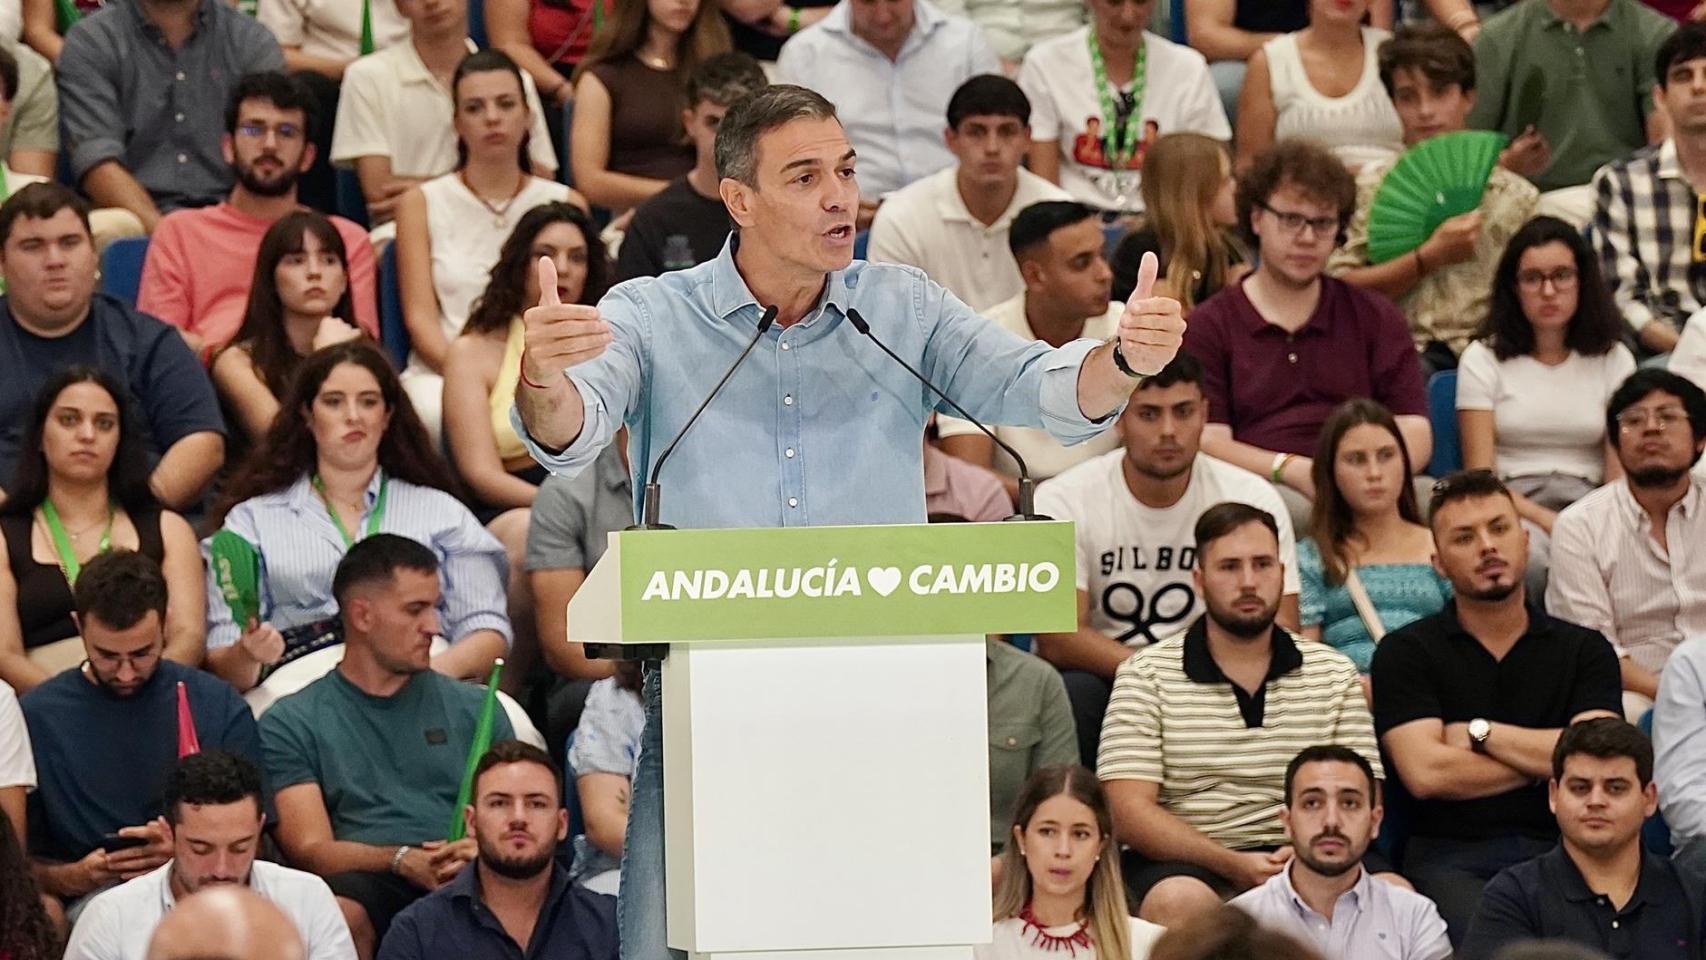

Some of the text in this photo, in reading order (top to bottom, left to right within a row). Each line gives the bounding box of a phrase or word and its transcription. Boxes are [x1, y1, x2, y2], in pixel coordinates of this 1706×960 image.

[1101, 546, 1199, 576] SILBO
[642, 559, 1059, 600] ANDALUCÍA CAMBIO
